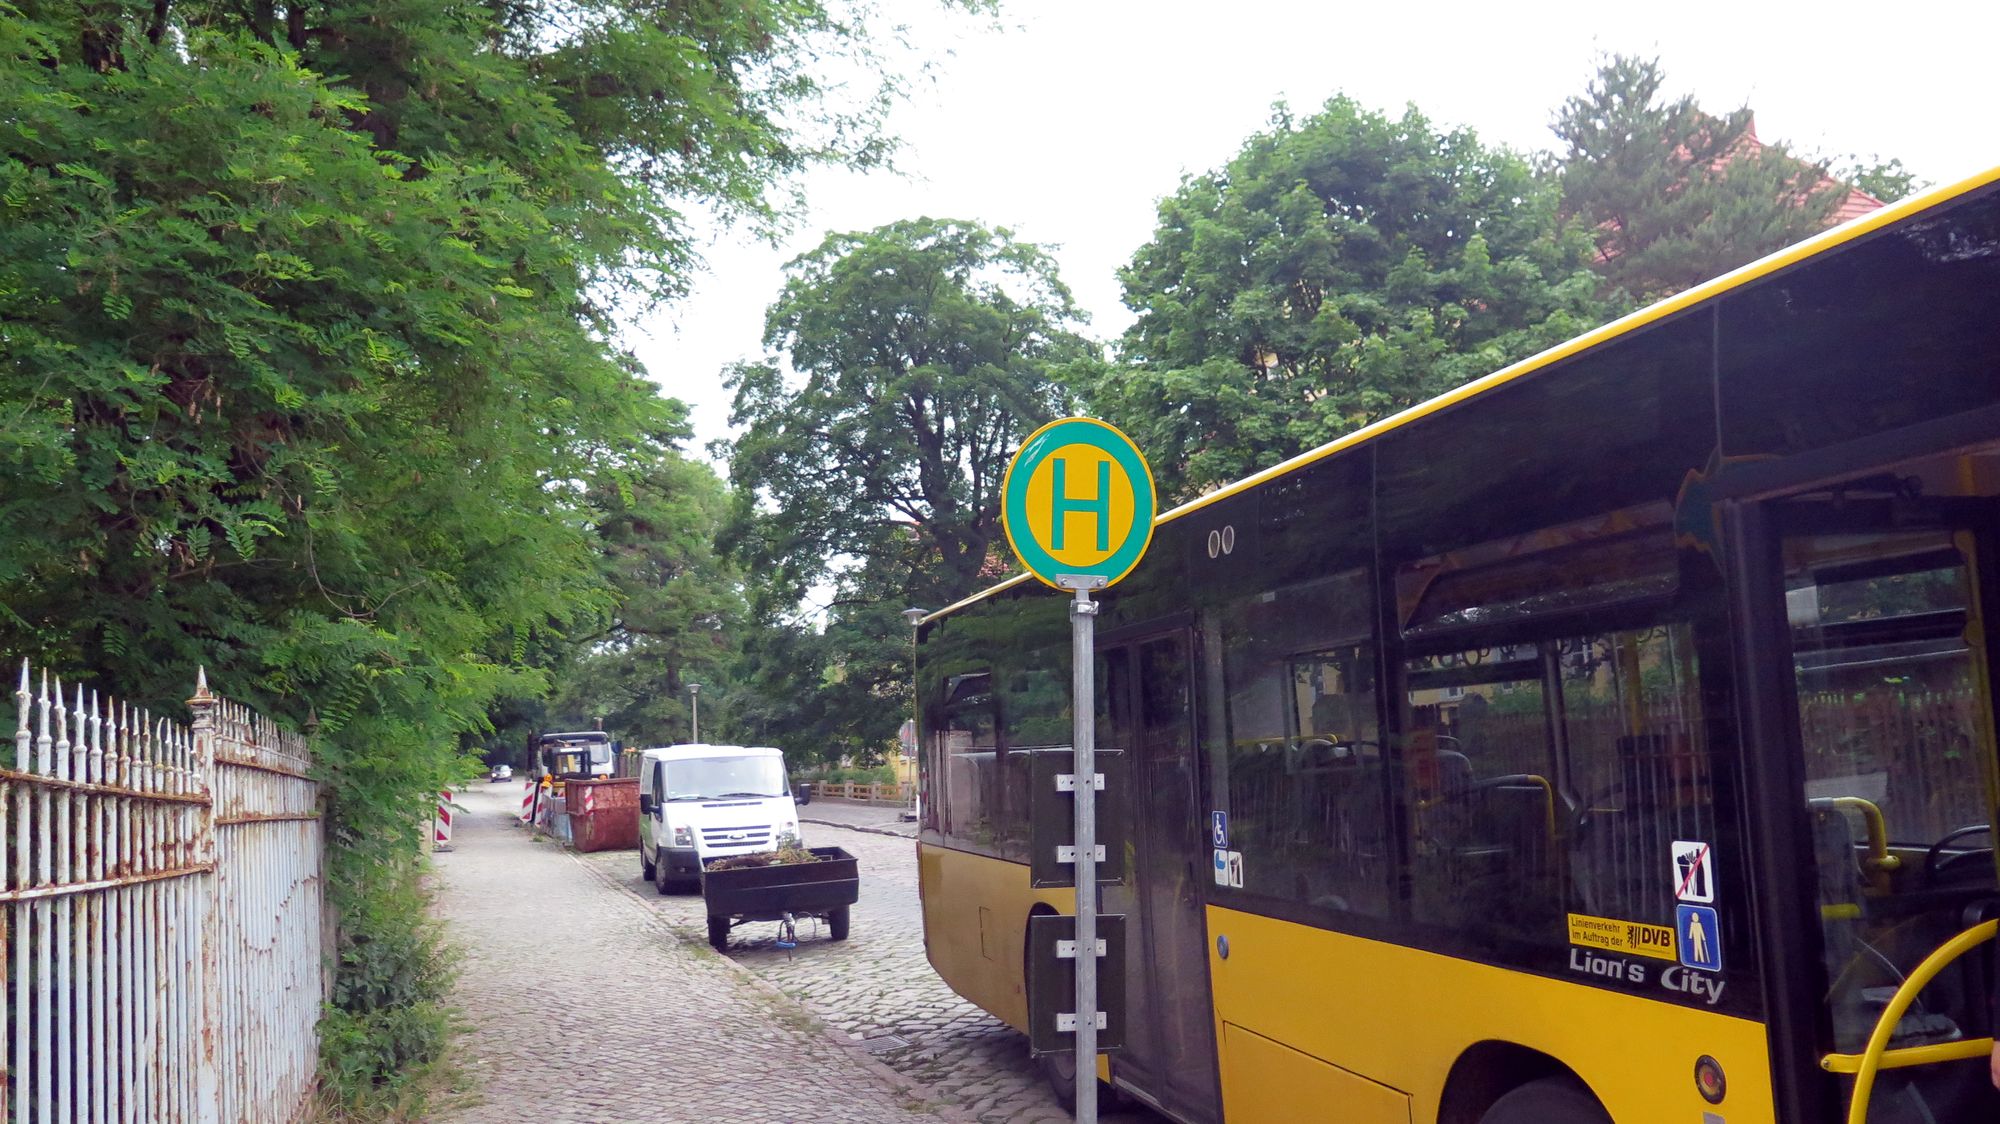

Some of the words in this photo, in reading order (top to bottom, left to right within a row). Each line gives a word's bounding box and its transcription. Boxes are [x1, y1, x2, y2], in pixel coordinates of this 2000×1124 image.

[1051, 457, 1111, 552] H
[1571, 917, 1621, 933] Linienverkehr
[1572, 929, 1582, 940] im
[1582, 930, 1610, 947] Auftrag
[1610, 935, 1623, 947] der
[1641, 926, 1671, 947] DVB
[1569, 948, 1646, 984] Lion's
[1660, 965, 1726, 1005] City
